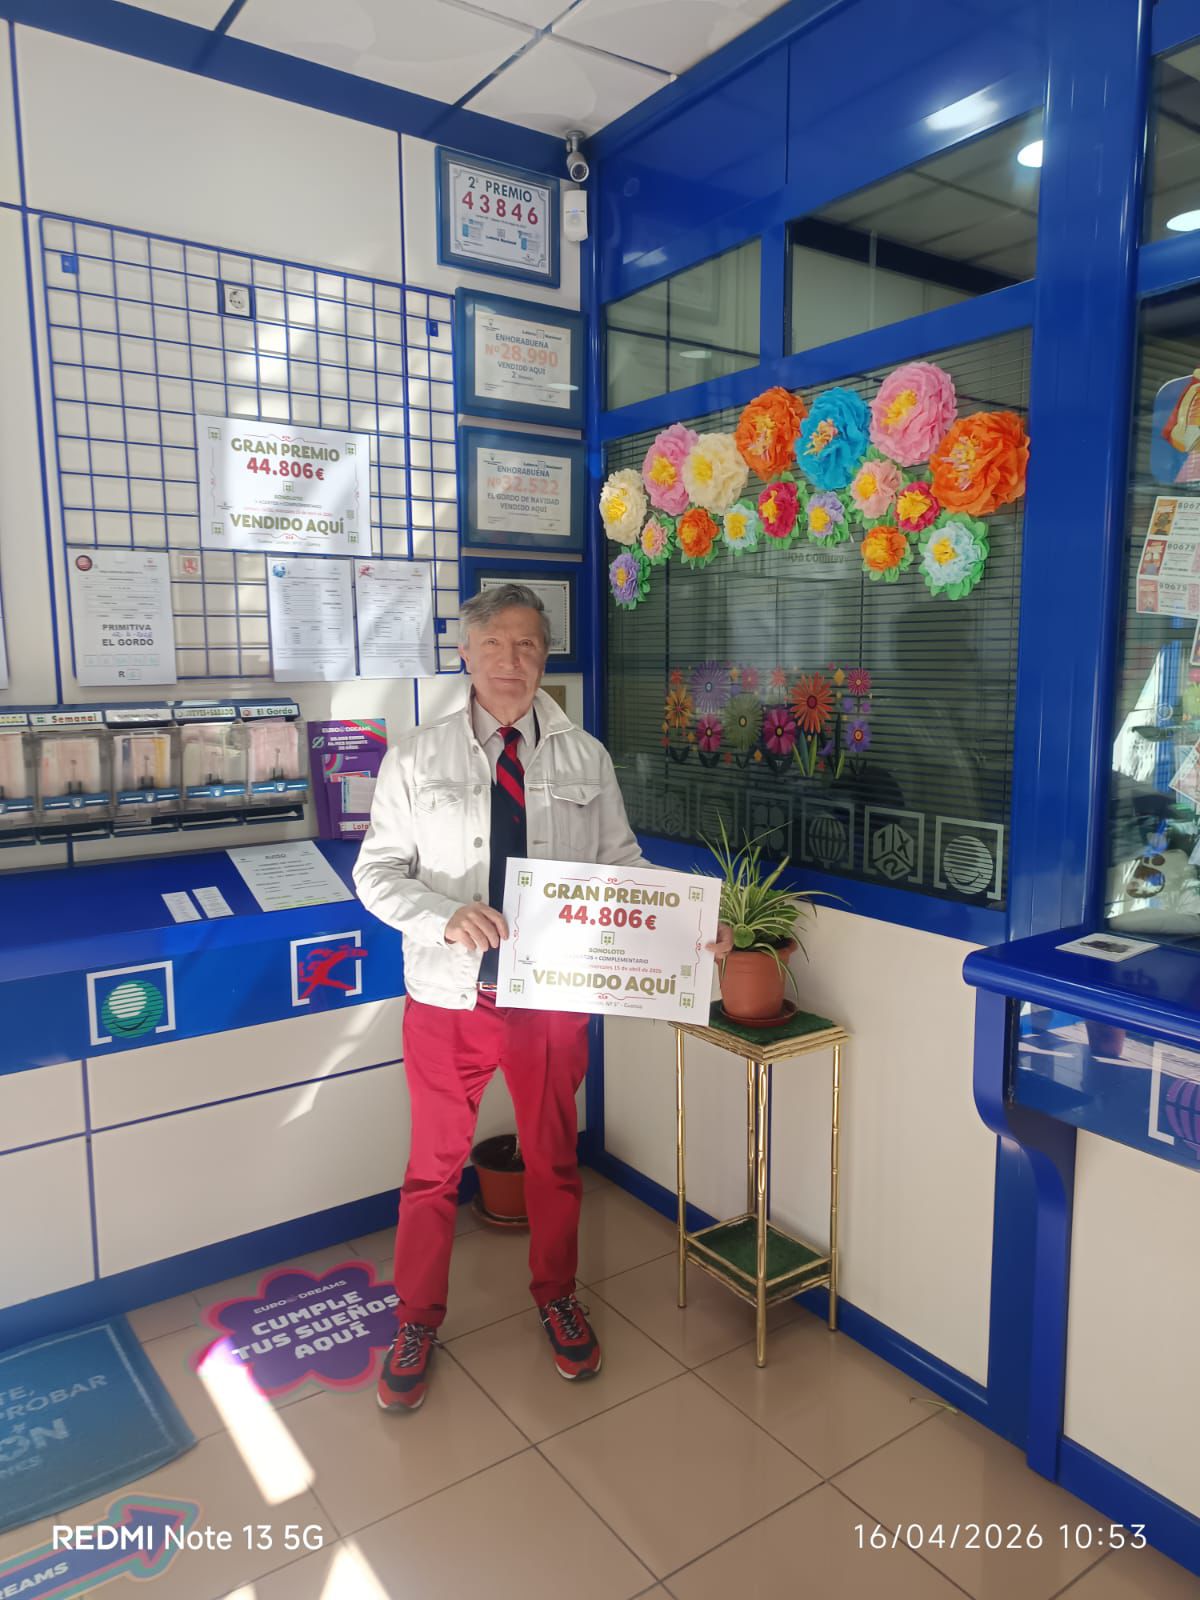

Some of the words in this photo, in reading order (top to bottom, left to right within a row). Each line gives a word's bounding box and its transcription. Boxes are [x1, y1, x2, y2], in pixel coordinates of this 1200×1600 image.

[486, 180, 532, 203] PREMIO
[462, 191, 538, 225] 43846
[495, 333, 549, 349] ENHORABUENA
[497, 361, 528, 372] VENDIDO
[231, 438, 277, 456] GRAN
[281, 443, 340, 462] PREMIO
[247, 457, 325, 480] 44.806€
[497, 465, 550, 478] ENHORABUENA
[496, 494, 519, 502] GORDO
[531, 497, 560, 506] NAVIDAD
[500, 503, 530, 512] VENDIDO
[230, 513, 303, 531] VENDIDO
[306, 517, 344, 536] AQUÍ
[102, 638, 115, 646] EL
[118, 638, 154, 646] GORDO
[118, 670, 126, 678] R
[52, 713, 97, 724] Semanal
[257, 706, 265, 715] El
[267, 706, 293, 714] Gordo
[543, 882, 600, 901] GRAN
[603, 886, 681, 908] PREMIO
[558, 904, 657, 931] 44.806€
[598, 955, 649, 965] COMPLEMENTARIO
[533, 969, 621, 990] VENDIDO
[625, 974, 676, 995] AQUÍ
[254, 1299, 287, 1314] EURO
[298, 1279, 348, 1299] DREAMS
[251, 1291, 363, 1336] CUMPLE
[232, 1332, 291, 1360] TUS
[295, 1294, 400, 1340] SUEÑOS
[294, 1321, 371, 1359] AQUÍ
